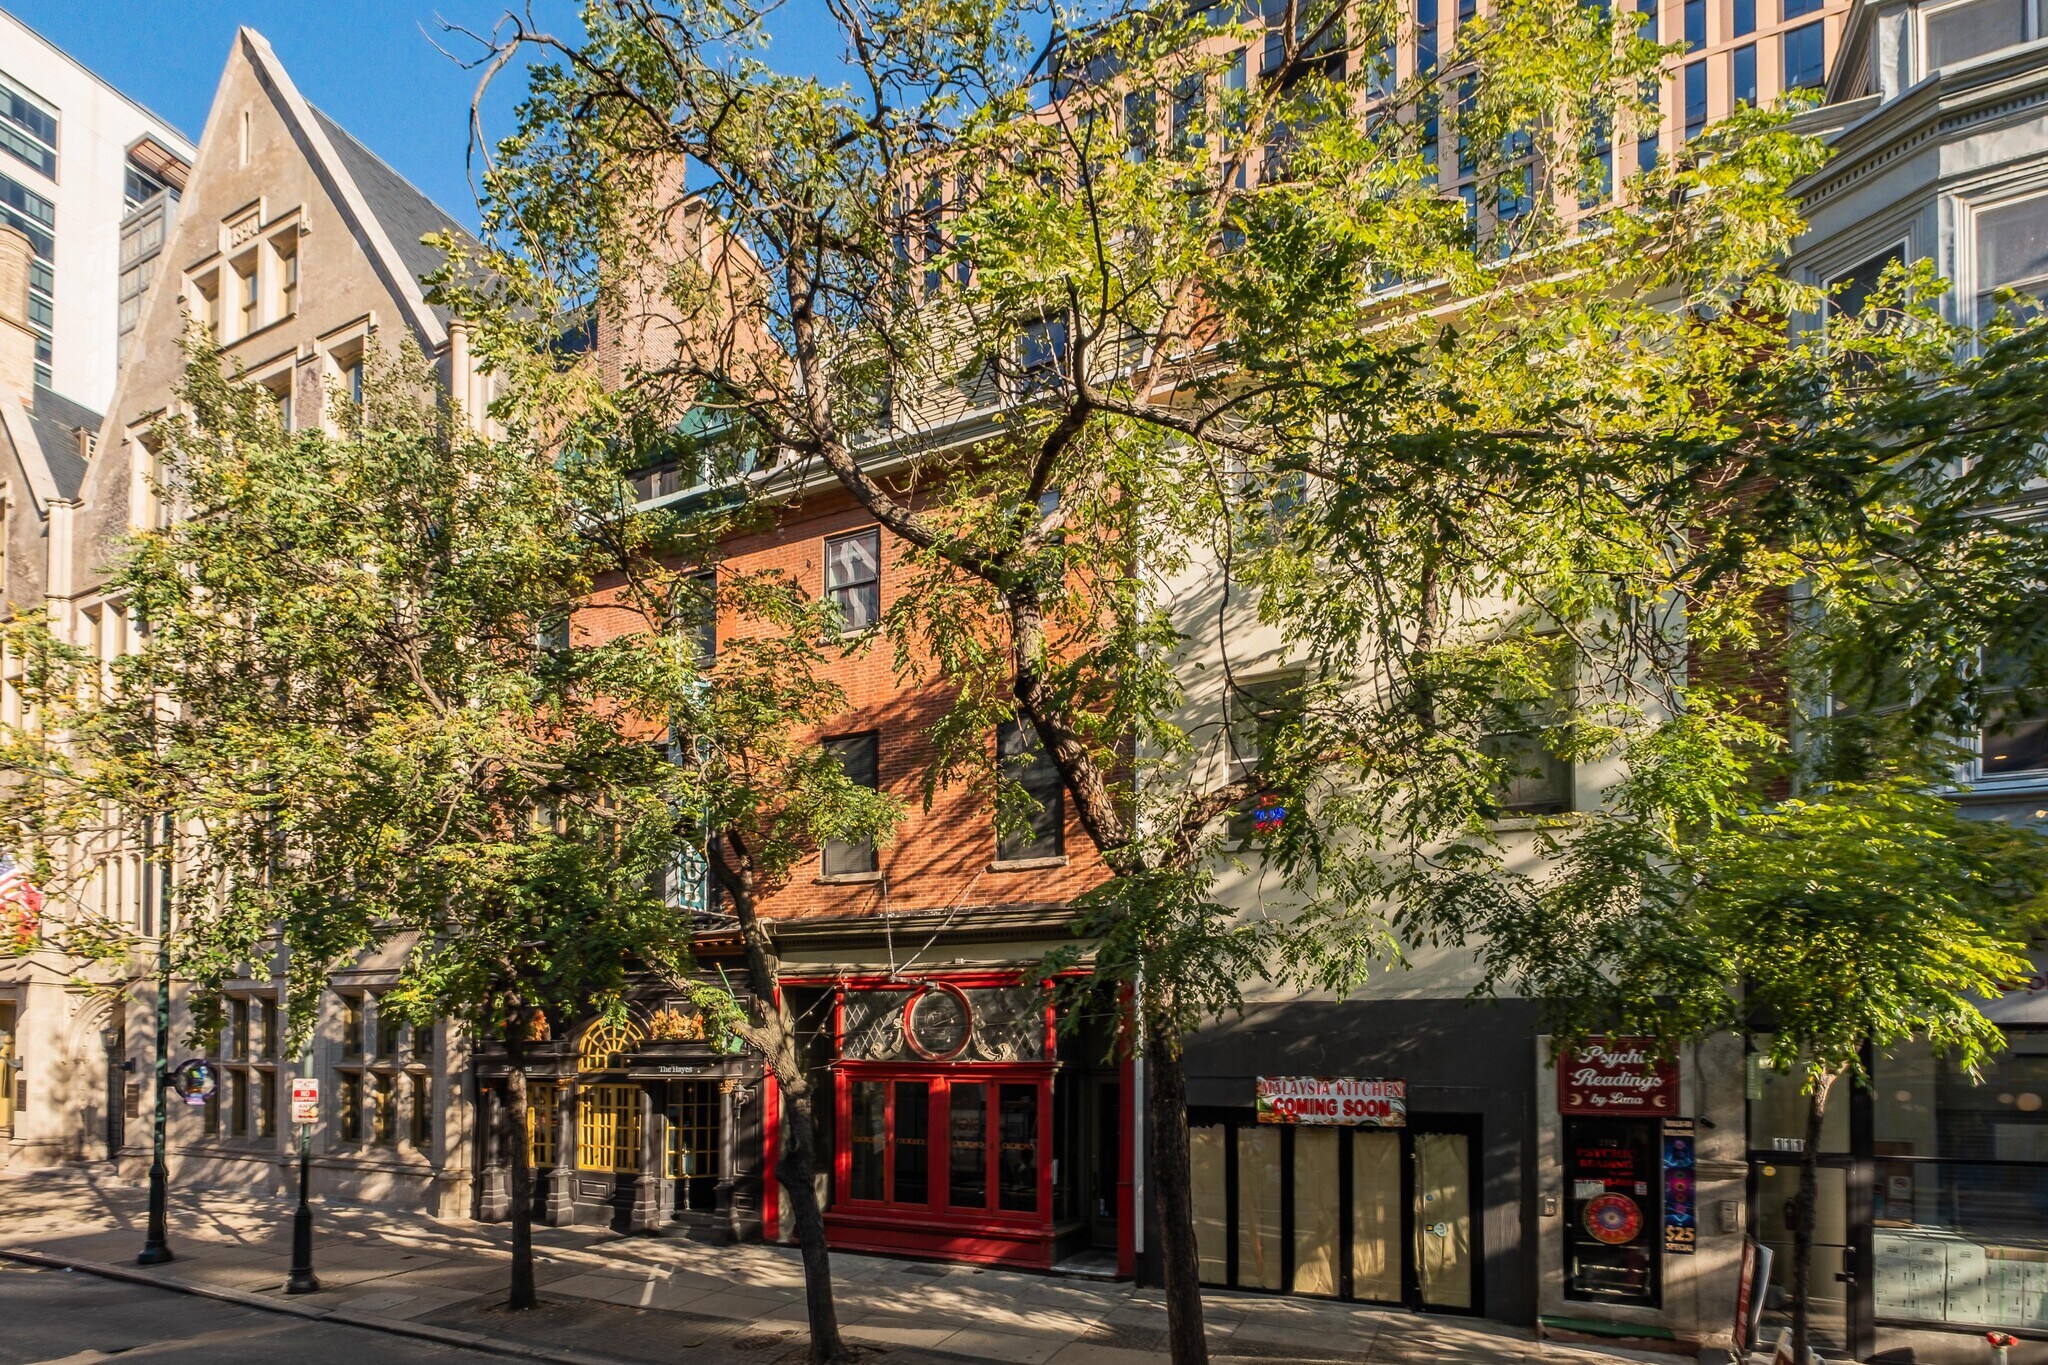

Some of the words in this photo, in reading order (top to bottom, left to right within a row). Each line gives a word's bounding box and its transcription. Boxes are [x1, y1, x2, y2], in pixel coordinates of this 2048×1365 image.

[1578, 1045, 1649, 1067] Psychi
[658, 1065, 672, 1073] The
[672, 1065, 693, 1074] Hayes
[1262, 1080, 1330, 1096] MALAYSIA
[1336, 1081, 1403, 1097] KITCHEN
[1572, 1068, 1663, 1092] Readings
[1272, 1097, 1338, 1116] COMING
[1343, 1099, 1392, 1117] SOON
[1590, 1093, 1607, 1107] by
[1664, 1224, 1696, 1242] $25
